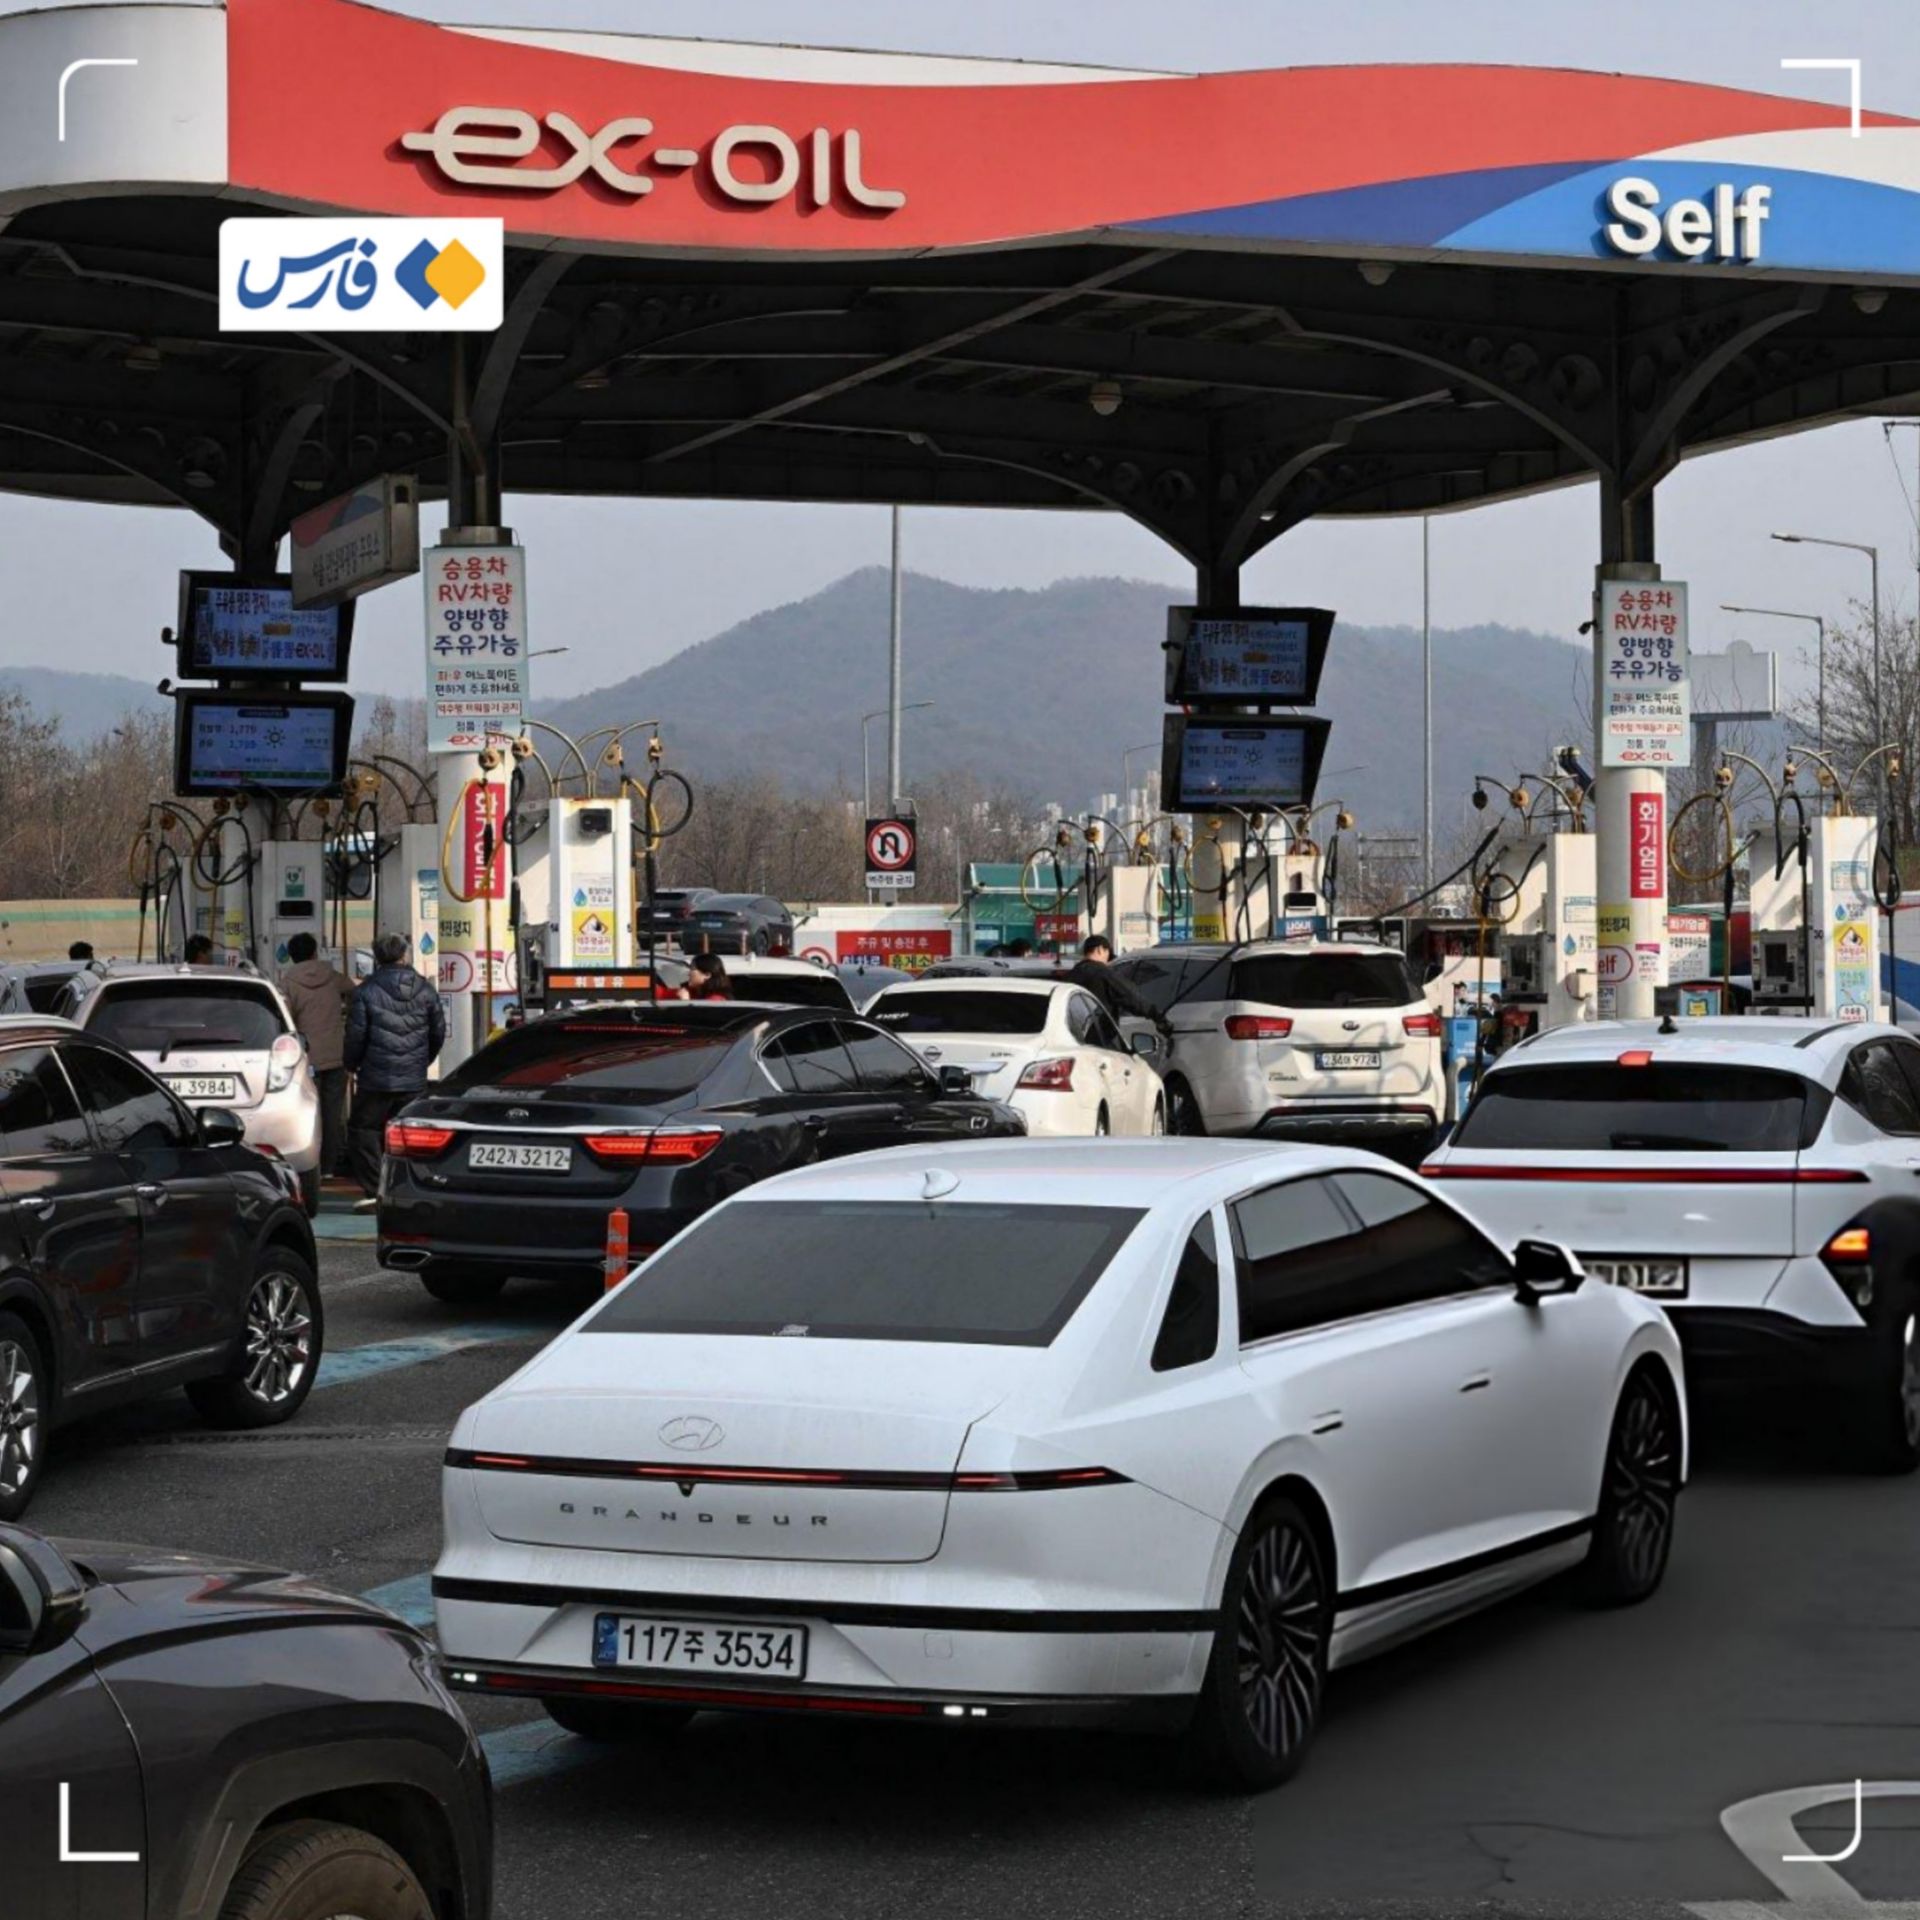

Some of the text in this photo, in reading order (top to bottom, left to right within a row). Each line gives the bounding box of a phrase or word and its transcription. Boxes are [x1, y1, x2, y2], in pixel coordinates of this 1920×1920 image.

[1604, 177, 1771, 259] Self
[442, 556, 508, 580] 승용차
[438, 583, 512, 605] RV차량
[1618, 590, 1673, 611] 승용차
[443, 608, 509, 631] 양방향
[1615, 613, 1677, 635] RV차량
[433, 634, 519, 656] 주유가능
[1619, 637, 1674, 658] 양방향
[1610, 661, 1683, 682] 주유가능
[435, 683, 520, 696] 편하게 주유하세요
[1639, 802, 1658, 889] 화기엄금
[858, 937, 878, 949] 주유
[439, 960, 456, 982] elf
[1598, 954, 1617, 973] elf
[1353, 1053, 1377, 1065] 9724
[188, 1081, 227, 1094] 3984
[520, 1148, 563, 1167] 3212
[560, 1502, 829, 1527] GRANDEUR
[623, 1623, 794, 1670] 117주 3534
